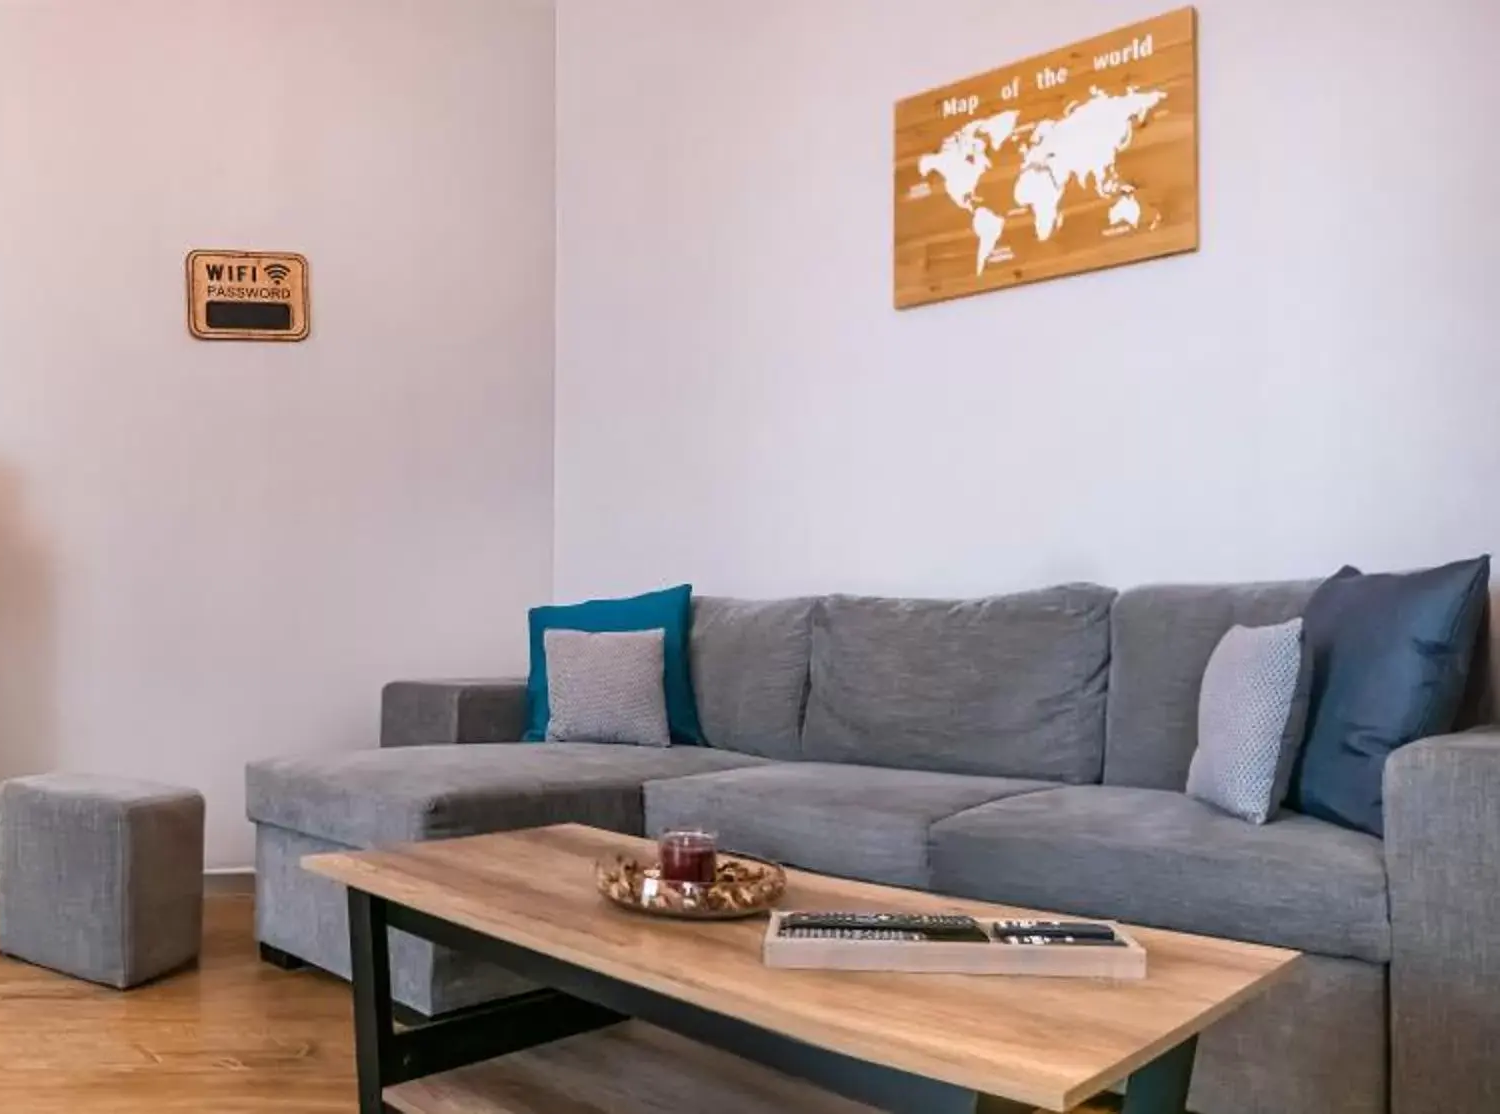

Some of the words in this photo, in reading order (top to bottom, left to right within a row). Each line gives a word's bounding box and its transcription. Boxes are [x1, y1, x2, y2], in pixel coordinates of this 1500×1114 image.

[943, 95, 979, 118] Map
[1001, 76, 1020, 100] of
[1036, 65, 1069, 89] the
[1093, 34, 1154, 70] world
[205, 264, 257, 283] WIFI
[206, 285, 292, 300] PASSWORD
